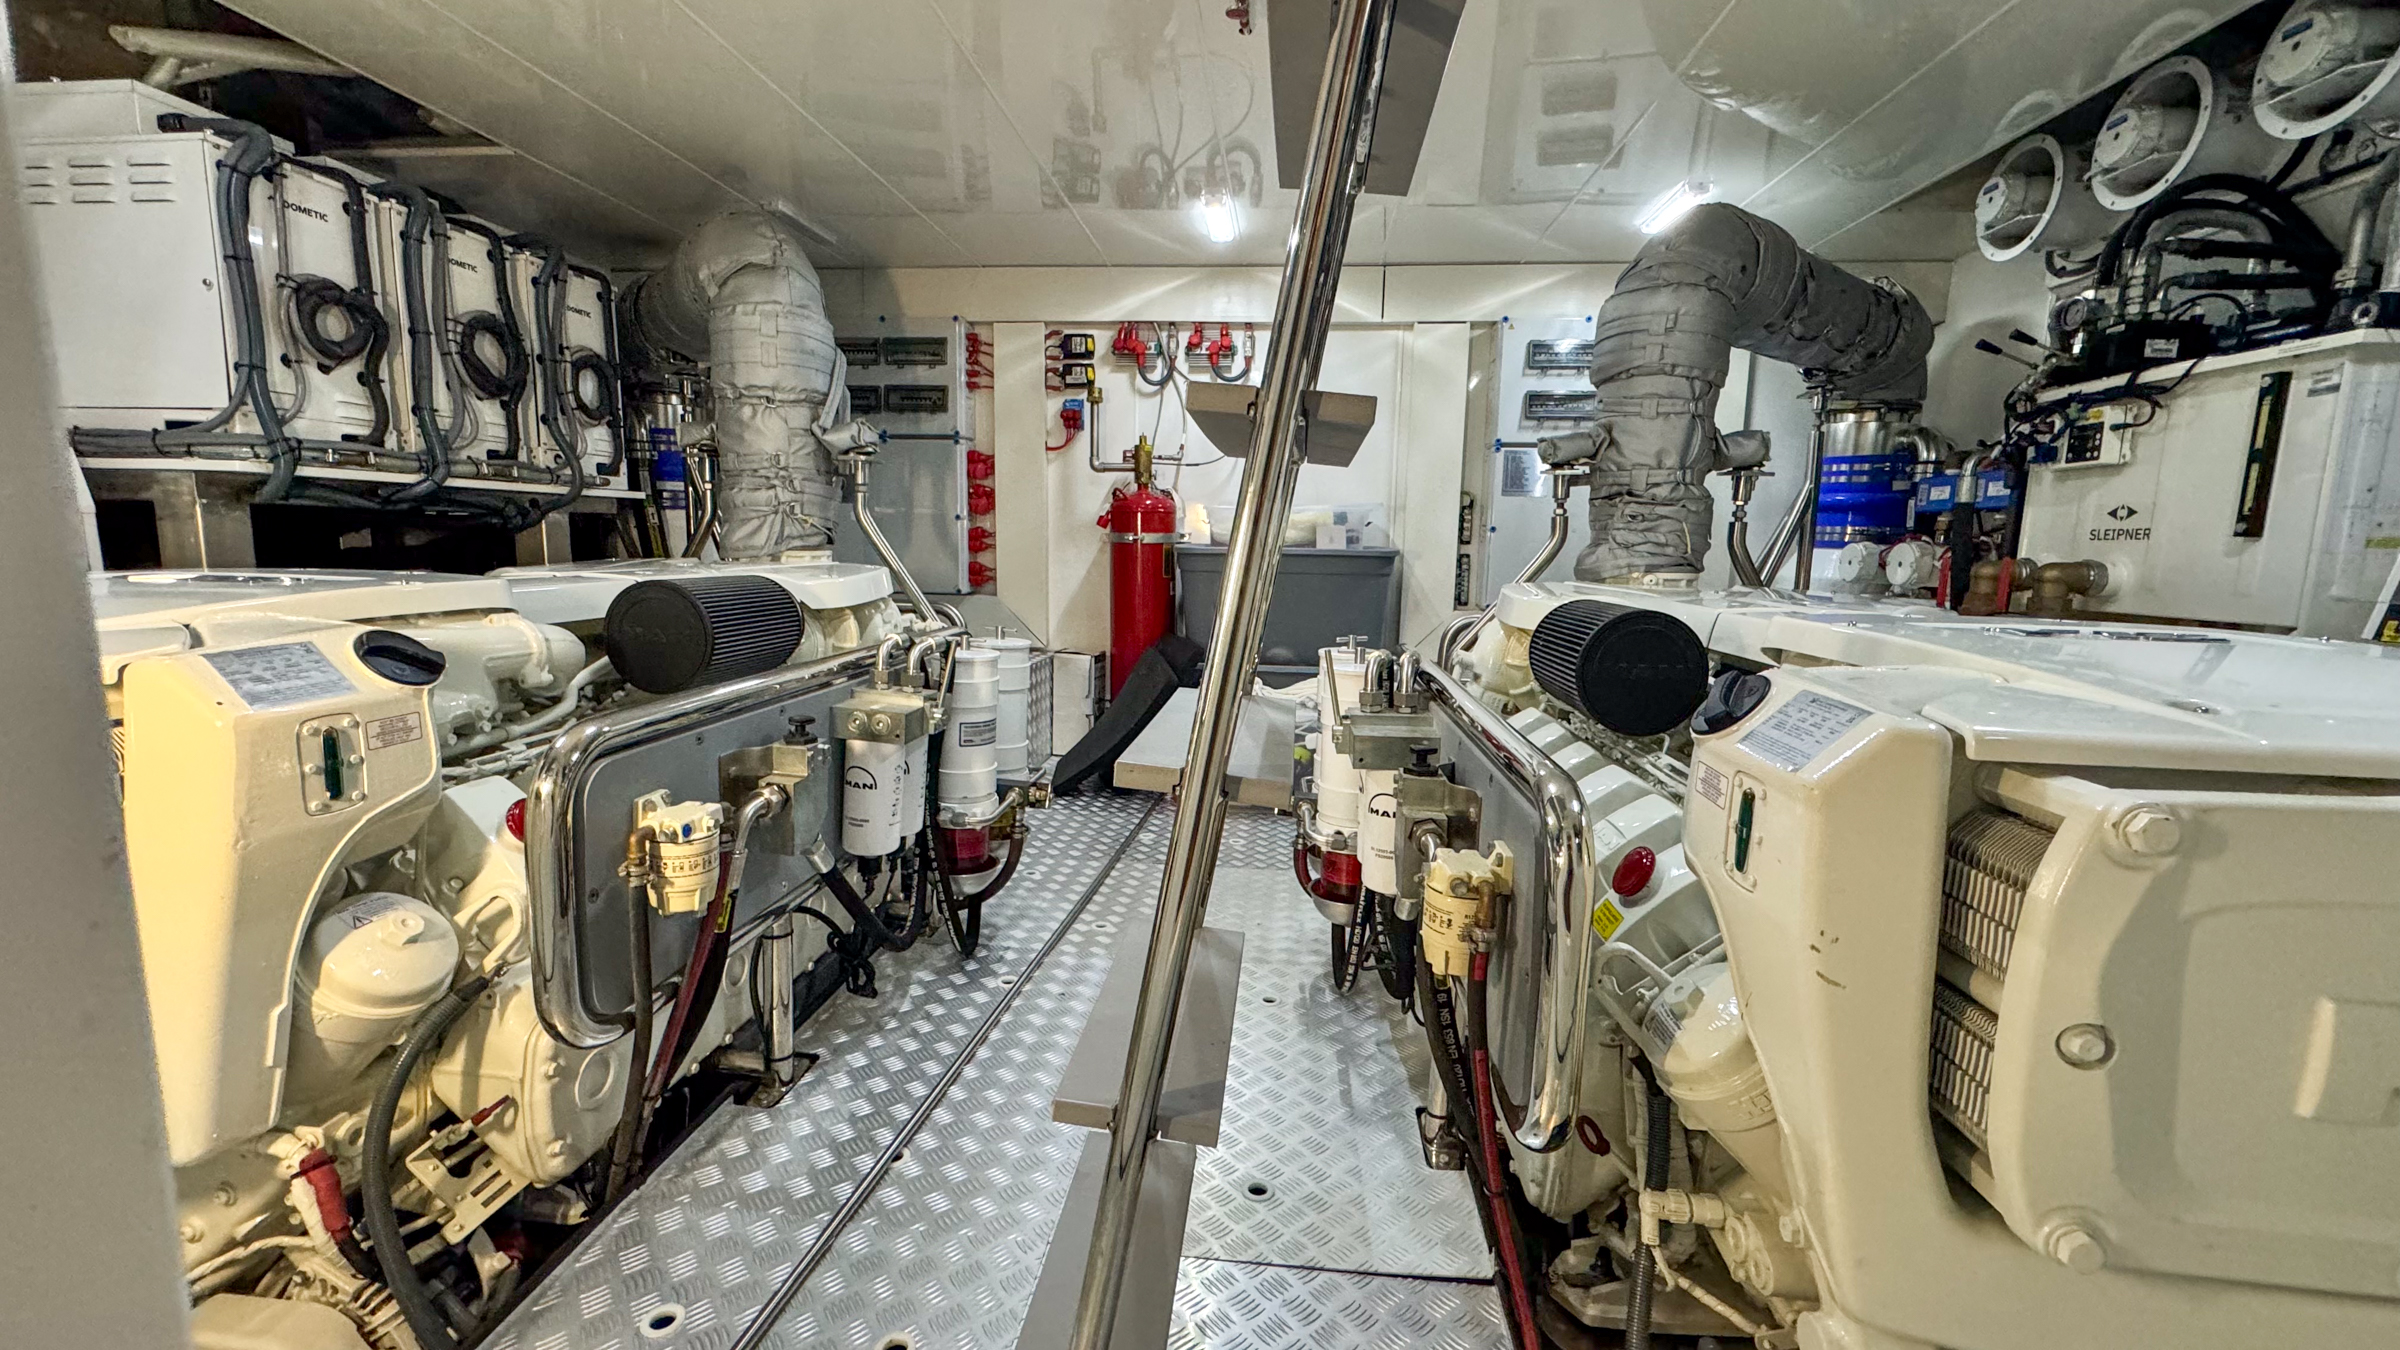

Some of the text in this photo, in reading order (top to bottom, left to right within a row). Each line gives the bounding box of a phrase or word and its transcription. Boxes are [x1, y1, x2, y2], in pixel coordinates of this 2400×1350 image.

[448, 258, 478, 273] OMETIC
[2089, 528, 2151, 541] SLEIPNER
[844, 779, 874, 790] MAN
[1437, 993, 1447, 1004] 19
[1439, 1008, 1451, 1026] 1SN
[1443, 1028, 1455, 1045] 853
[1447, 1045, 1459, 1059] EN
